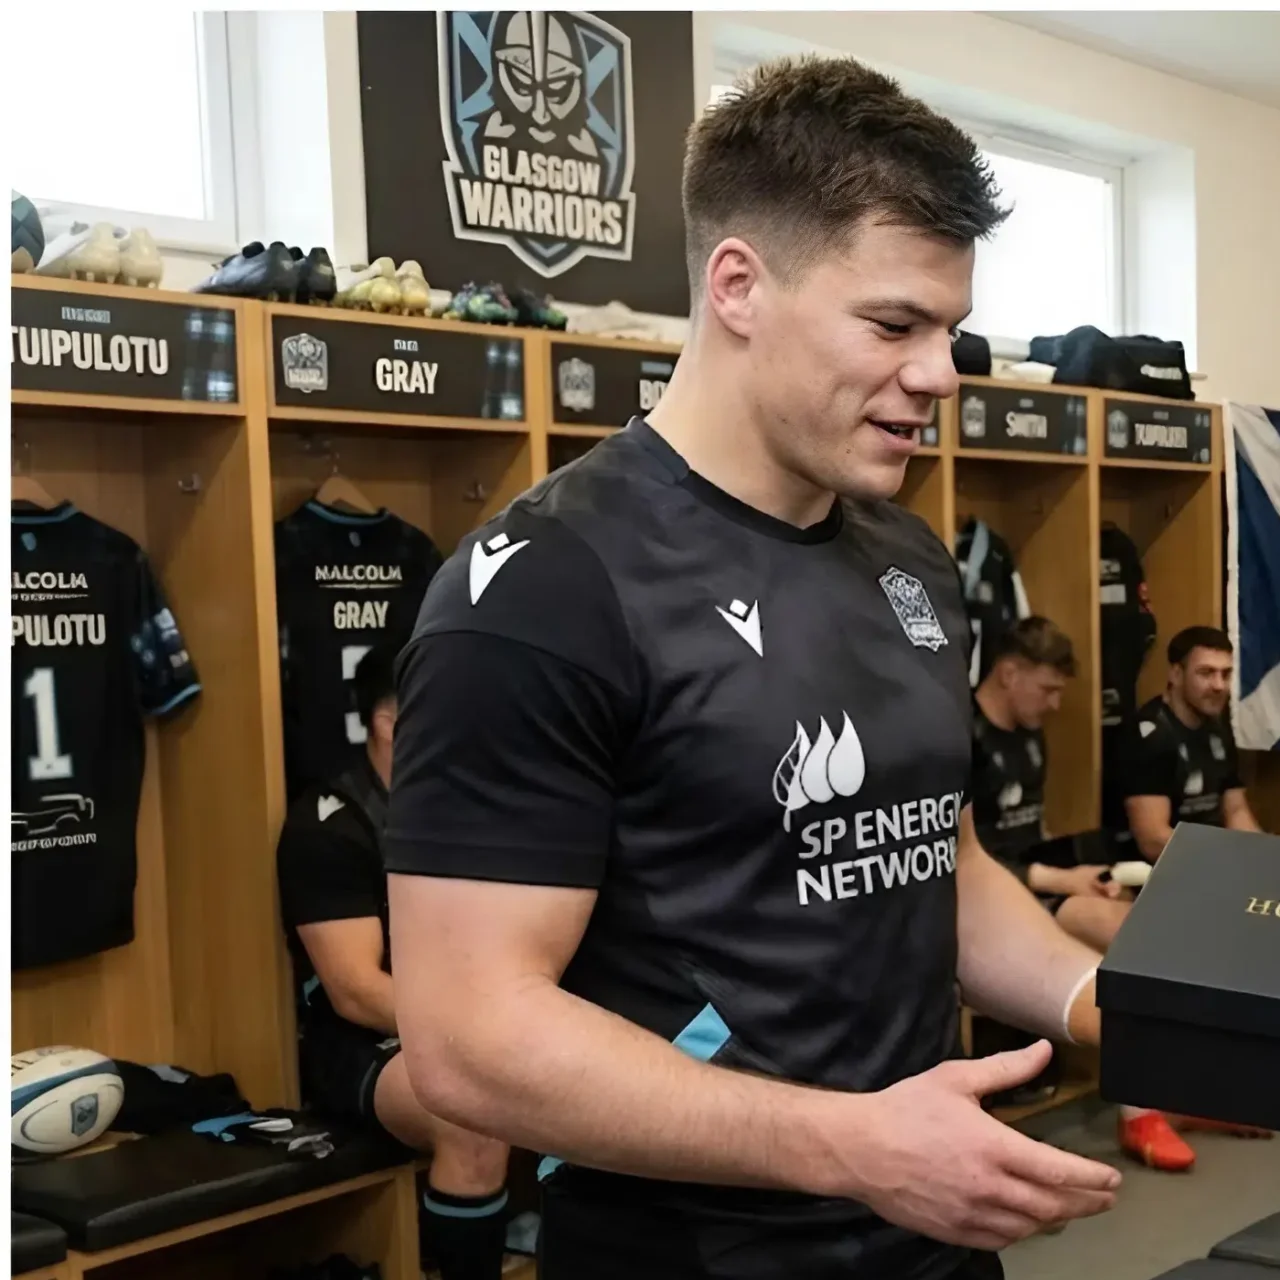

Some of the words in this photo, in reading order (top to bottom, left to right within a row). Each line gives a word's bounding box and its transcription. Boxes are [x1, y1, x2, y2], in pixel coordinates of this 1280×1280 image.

[483, 144, 600, 195] GLASGOW
[459, 178, 623, 245] WARRIORS
[375, 357, 438, 395] GRAY
[333, 601, 390, 630] GRAY
[24, 667, 73, 781] 1
[799, 817, 847, 860] SP
